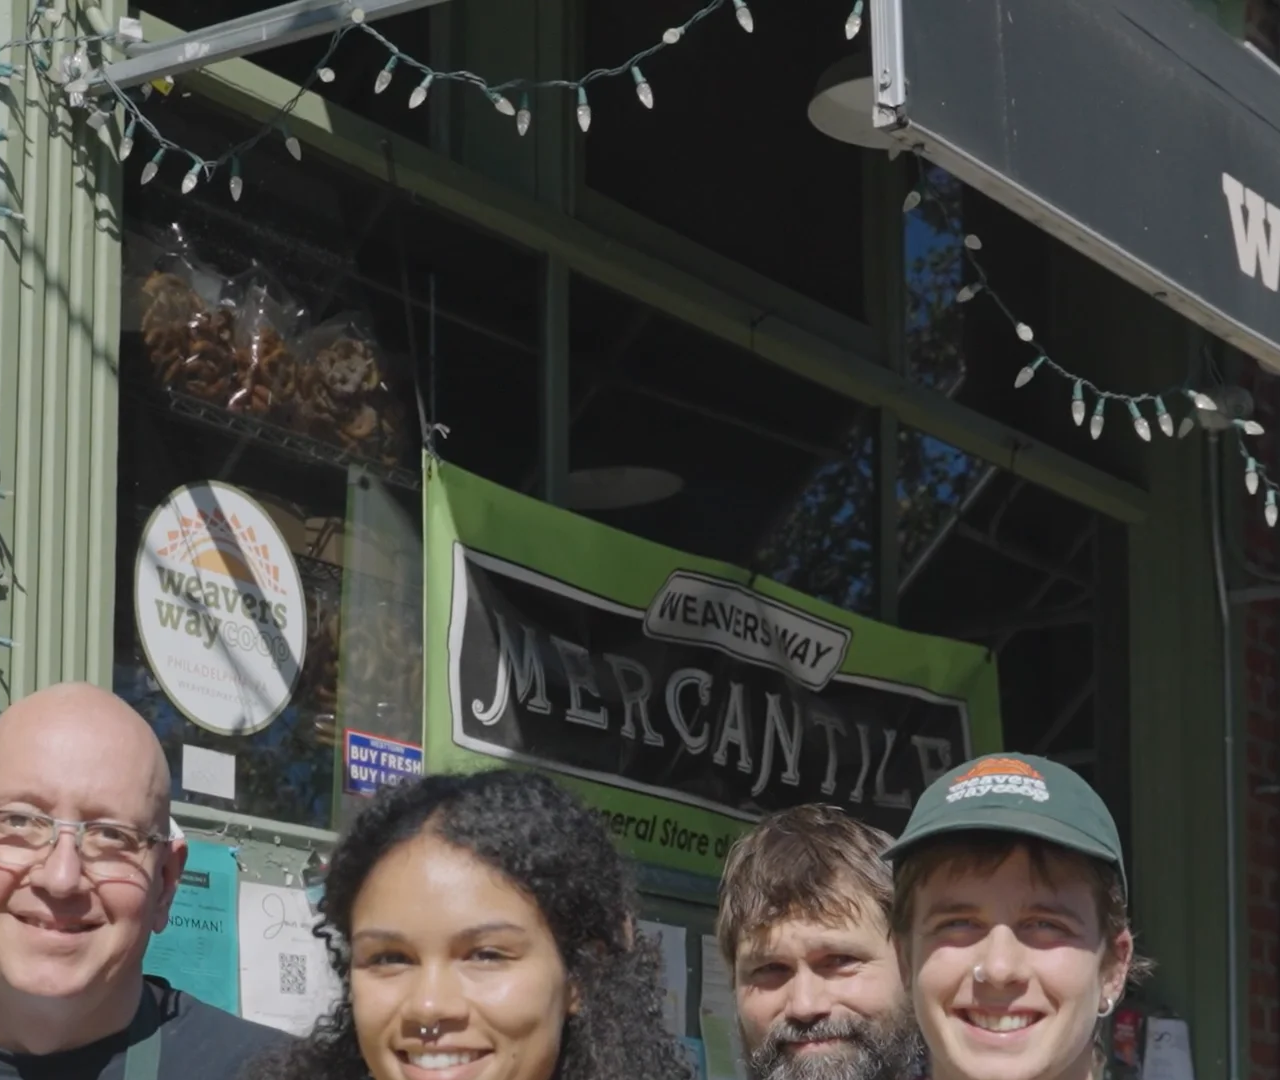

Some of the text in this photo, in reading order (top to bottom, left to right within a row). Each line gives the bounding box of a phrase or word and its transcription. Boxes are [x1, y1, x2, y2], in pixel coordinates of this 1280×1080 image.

[156, 565, 288, 631] weavers
[657, 590, 833, 669] WEAVERS WAY
[350, 745, 378, 764] BUY
[380, 752, 421, 775] FRESH
[350, 764, 378, 783] BUY
[948, 774, 1047, 793] weavers
[659, 818, 709, 856] Store
[168, 915, 224, 934] NDYMAN!
